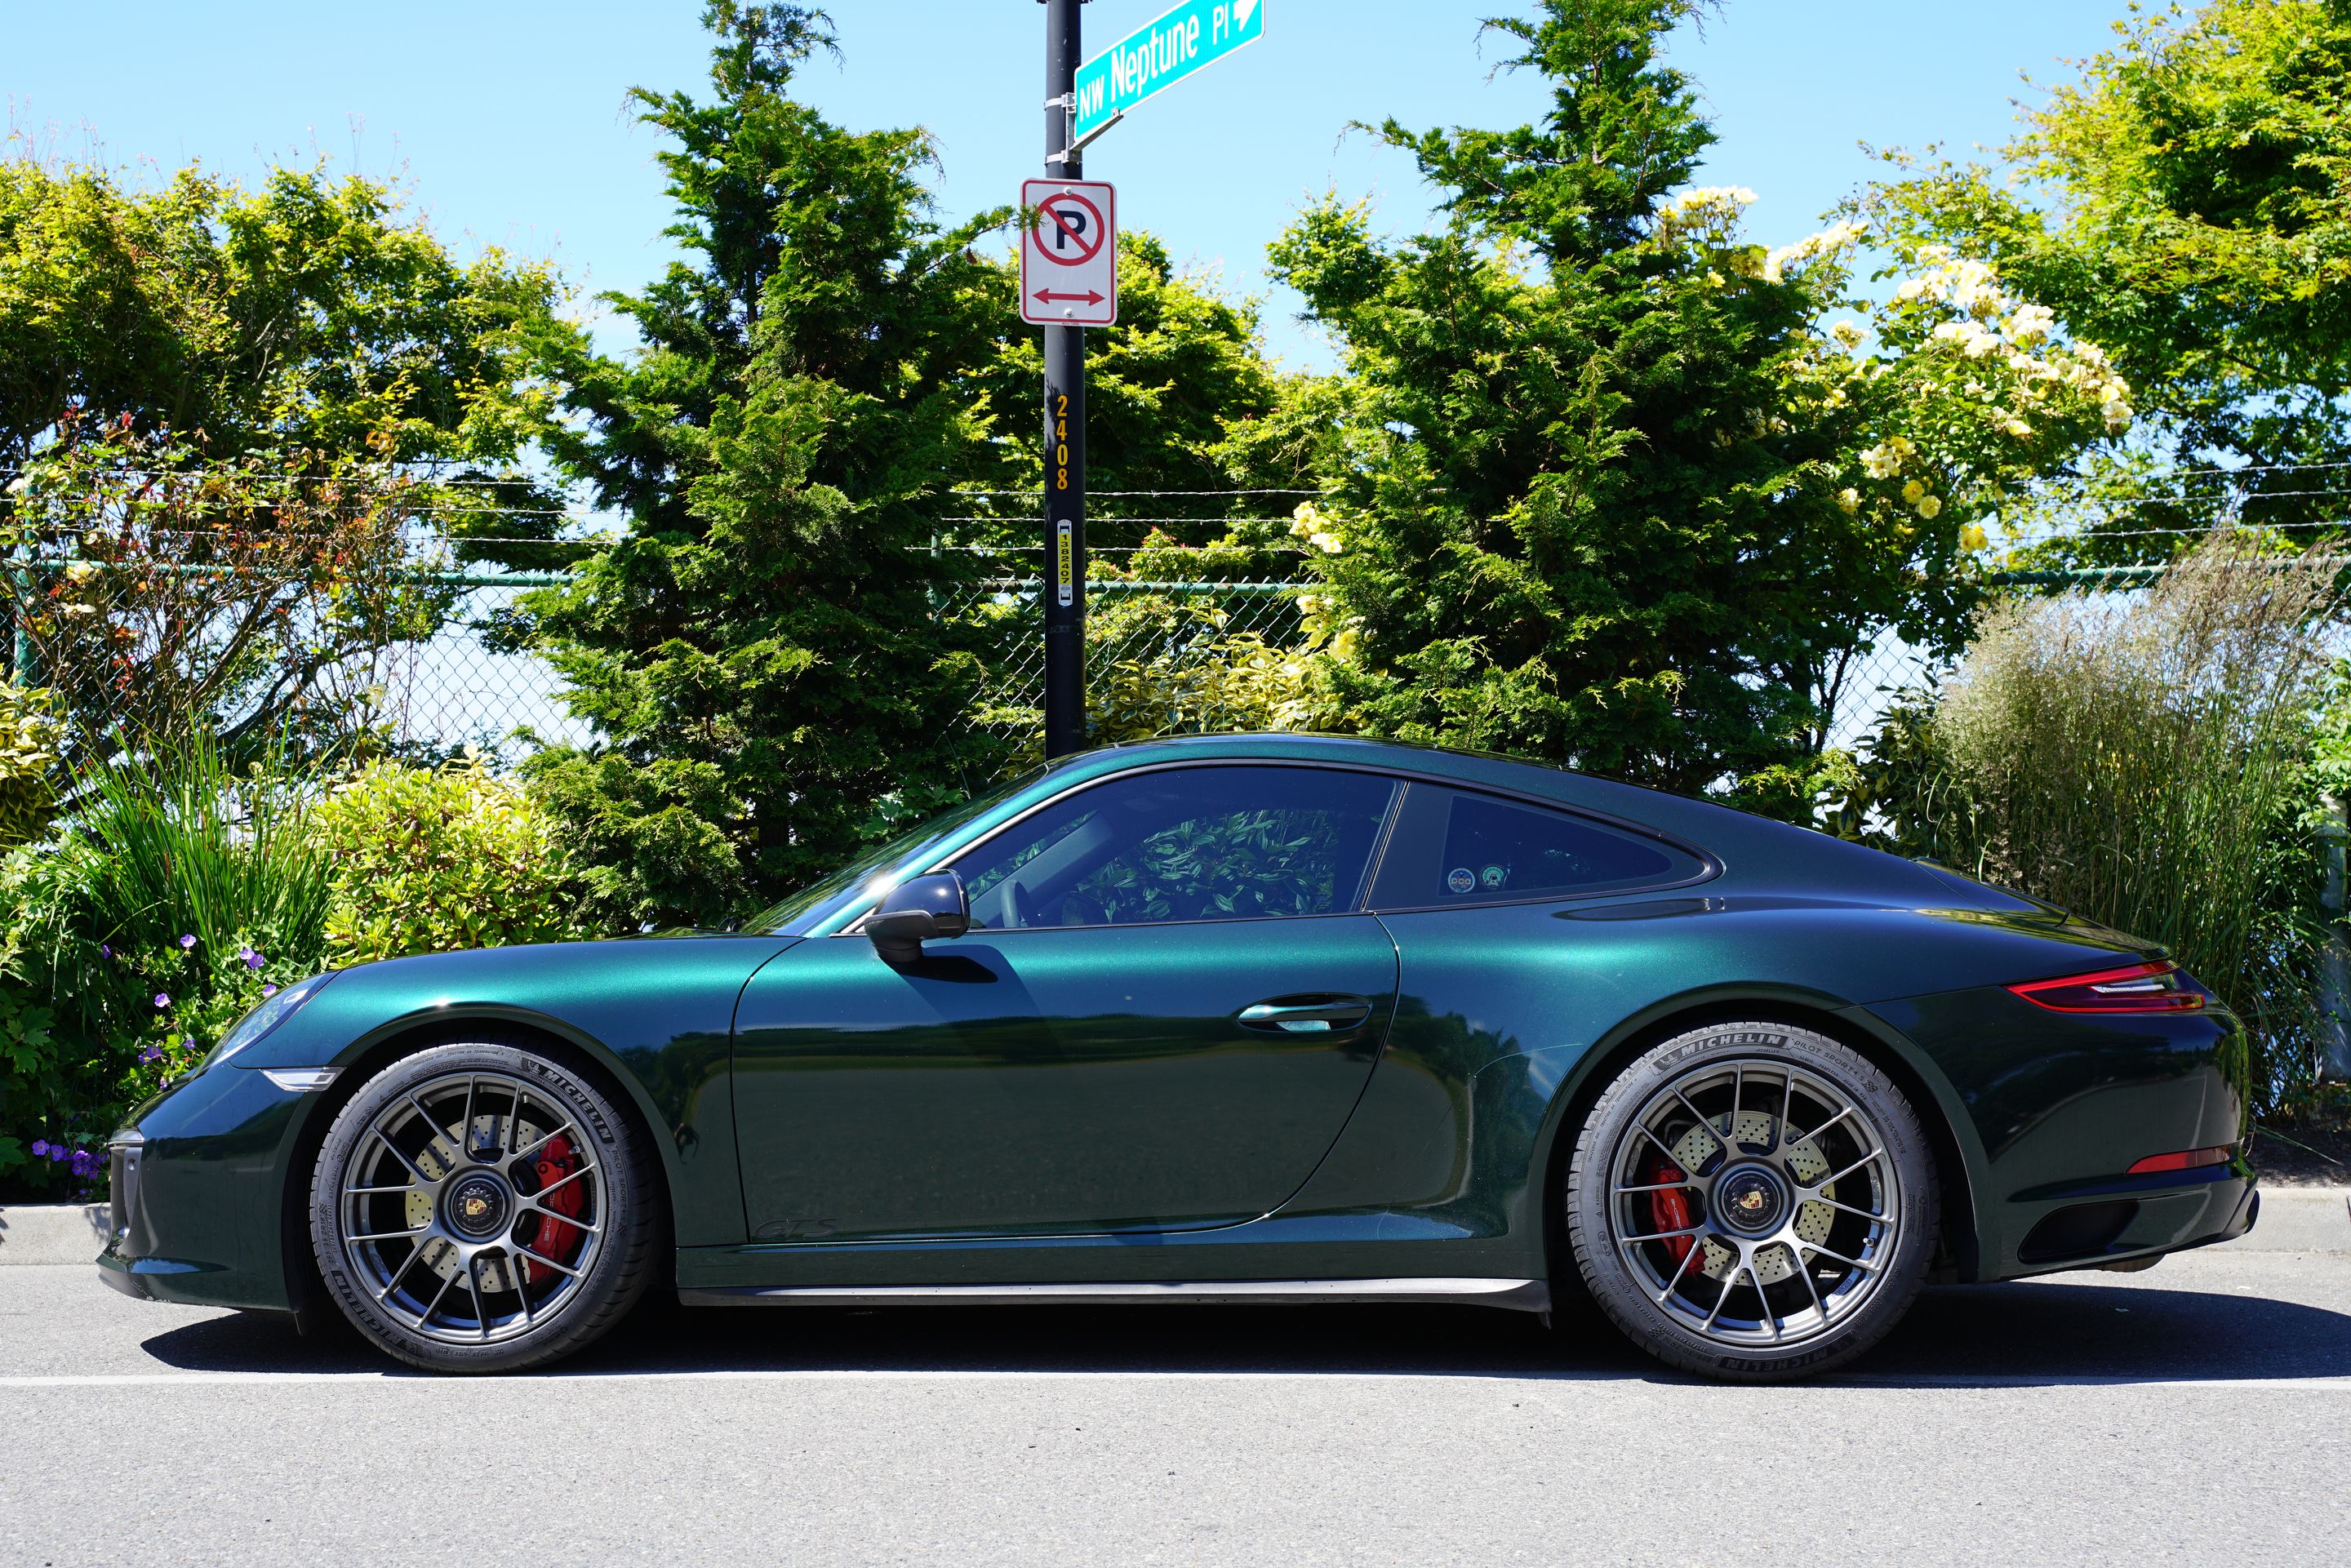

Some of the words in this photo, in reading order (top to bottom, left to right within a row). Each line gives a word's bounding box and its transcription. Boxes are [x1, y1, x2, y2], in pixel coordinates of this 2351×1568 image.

[1079, 74, 1105, 122] NW
[1110, 14, 1200, 103] Neptune
[1213, 2, 1229, 46] Pl
[1056, 210, 1087, 250] P
[1056, 394, 1069, 491] 2408
[1060, 534, 1070, 584] 1382407
[1682, 1033, 1781, 1056] MICHELIN
[1794, 1040, 1822, 1053] PILOT
[1824, 1052, 1855, 1072] SPORT
[544, 1069, 611, 1139] MICHELIN
[612, 1149, 624, 1174] PILOT
[619, 1178, 627, 1208] SPORT
[754, 1218, 838, 1238] GTS
[334, 1275, 402, 1344] MICHELIN
[1726, 1348, 1829, 1370] MICHELIN
